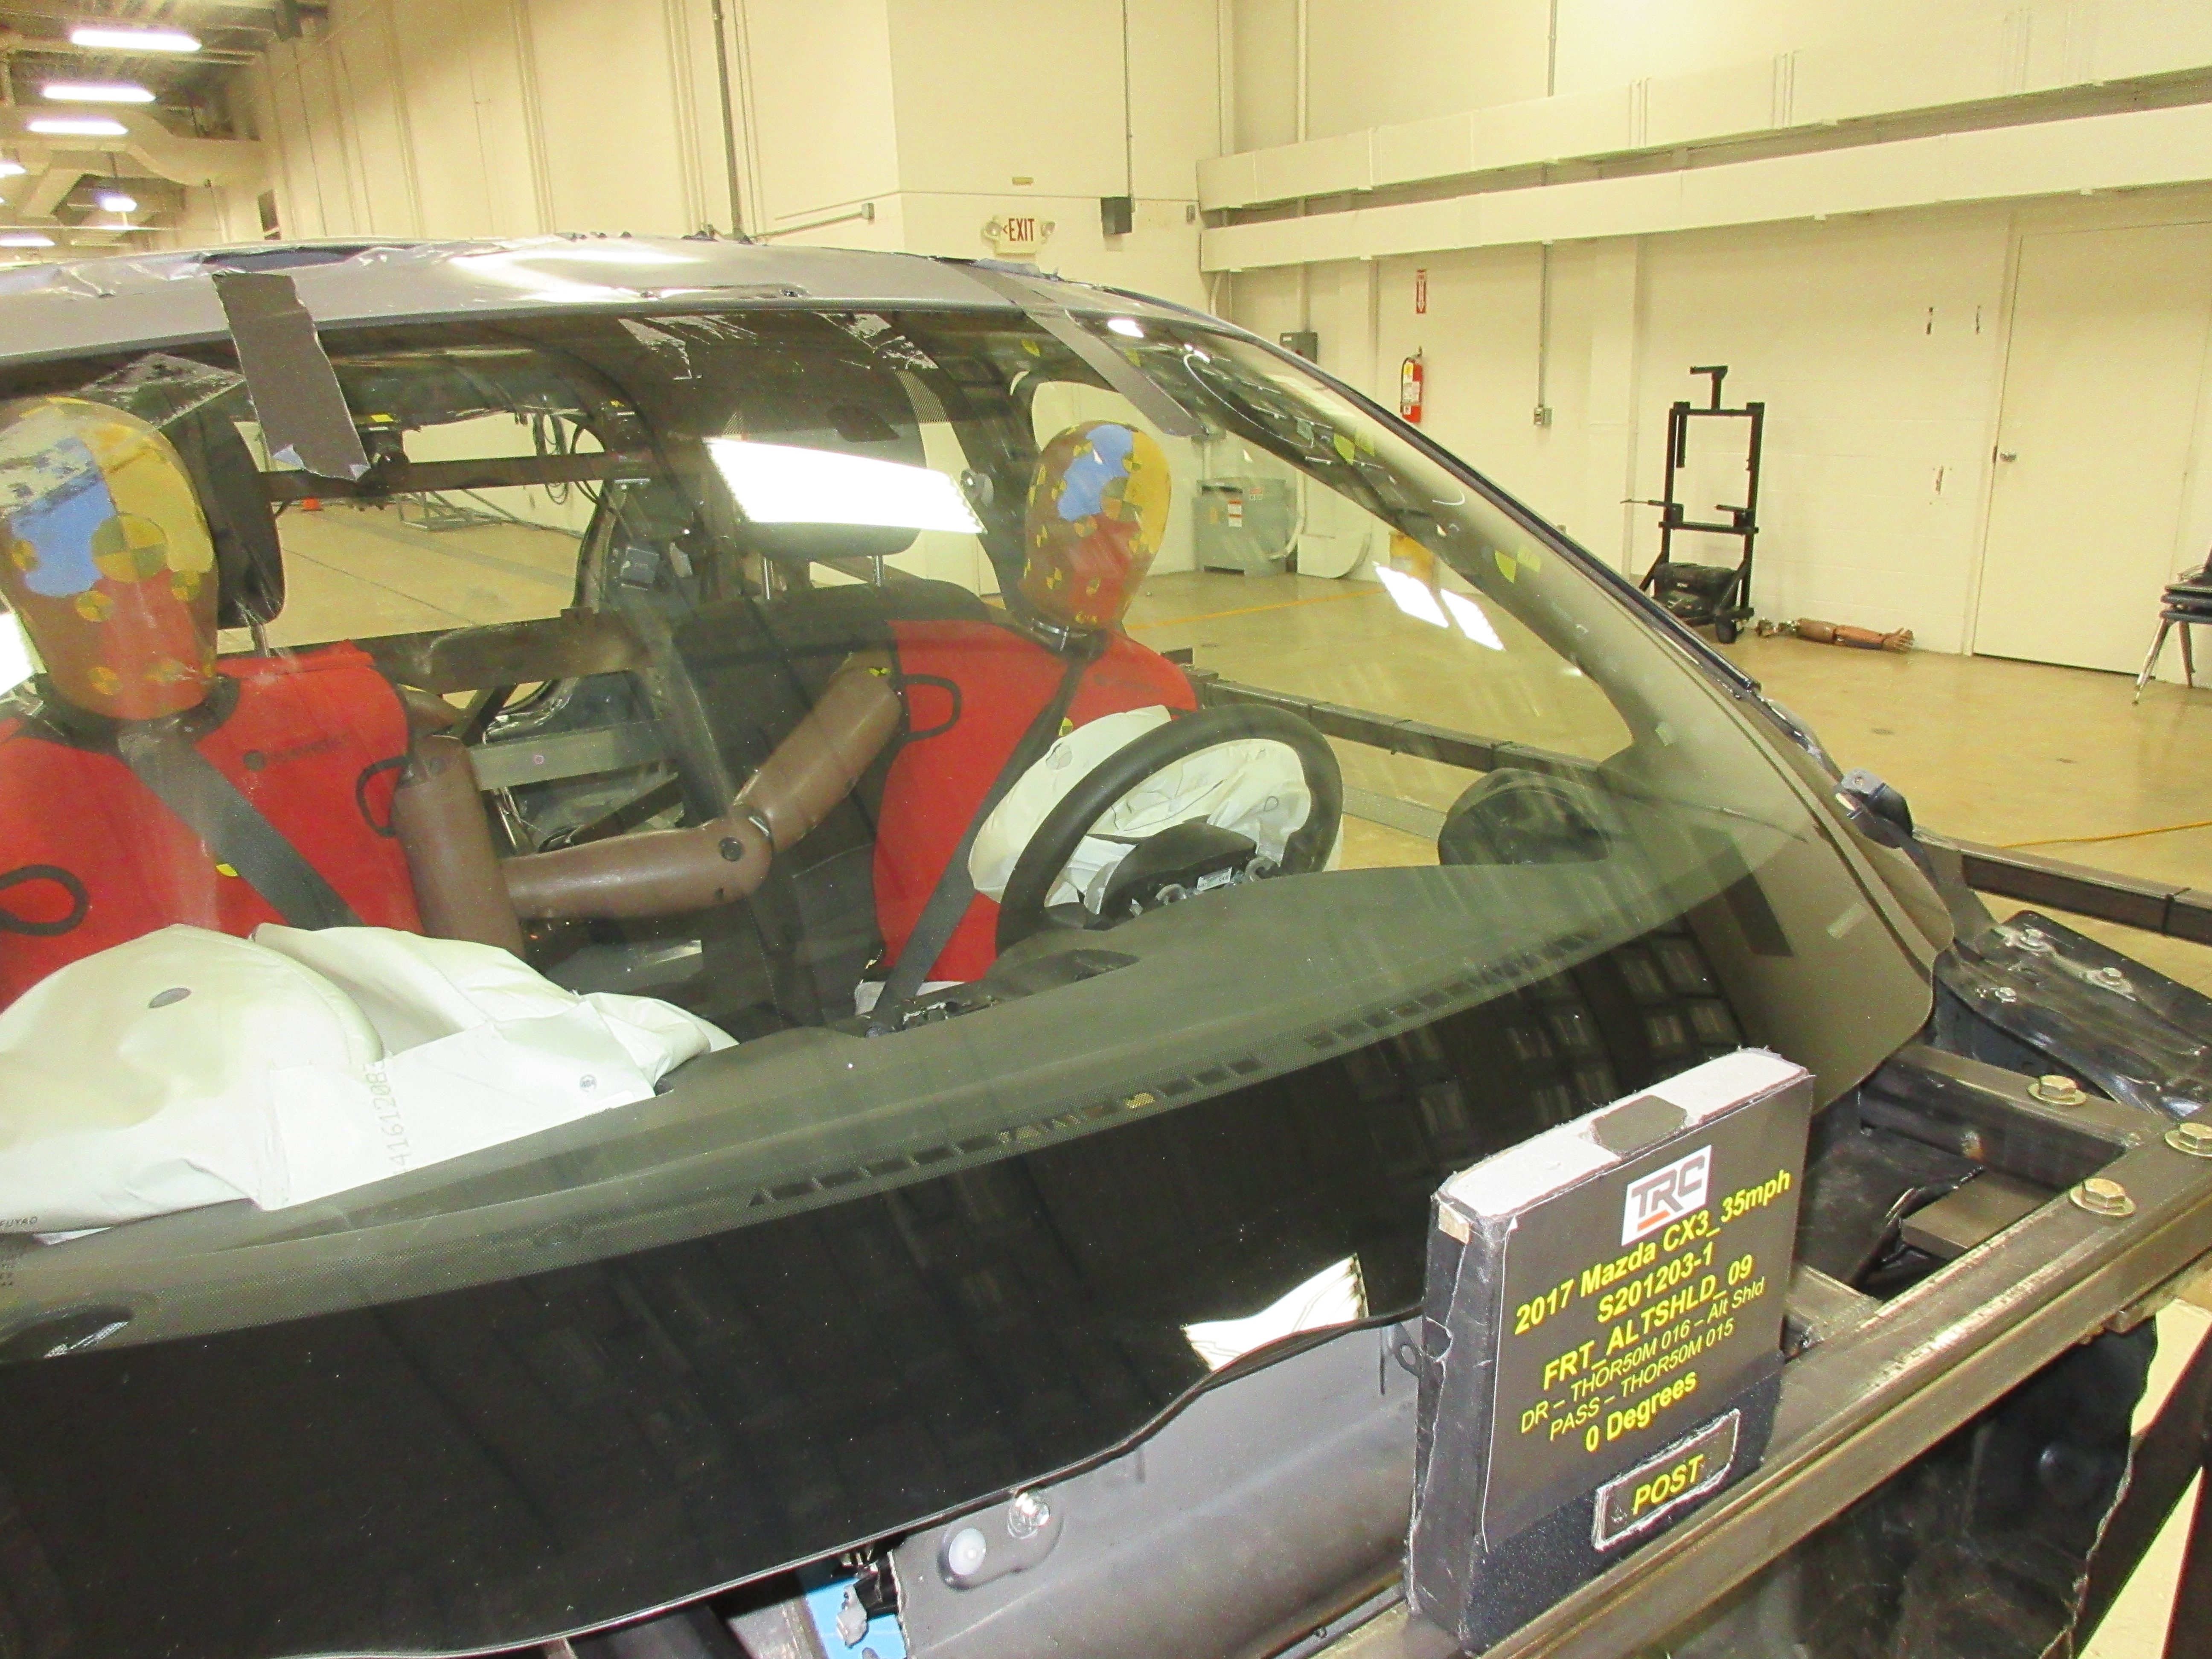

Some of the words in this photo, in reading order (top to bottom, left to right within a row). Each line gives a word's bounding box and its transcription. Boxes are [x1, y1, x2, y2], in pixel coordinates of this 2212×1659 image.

[1008, 218, 1036, 242] EXIT
[1631, 1153, 1705, 1216] TRC
[1515, 1279, 1574, 1335] 2017
[1580, 1243, 1656, 1297] Mazda
[1598, 1241, 1713, 1323] S201203-1
[1521, 1400, 1548, 1433] DR
[1571, 1338, 1657, 1401] THOR50M
[1662, 1319, 1690, 1349] 016
[1707, 1298, 1728, 1323] Alt
[1732, 1276, 1765, 1308] Shld
[1550, 1397, 1600, 1441] PASS
[1621, 1336, 1702, 1397] THOR50M
[1706, 1318, 1734, 1347] 015
[1586, 1425, 1599, 1452] 0
[1607, 1372, 1696, 1441] Degrees
[1633, 1454, 1703, 1515] POST
